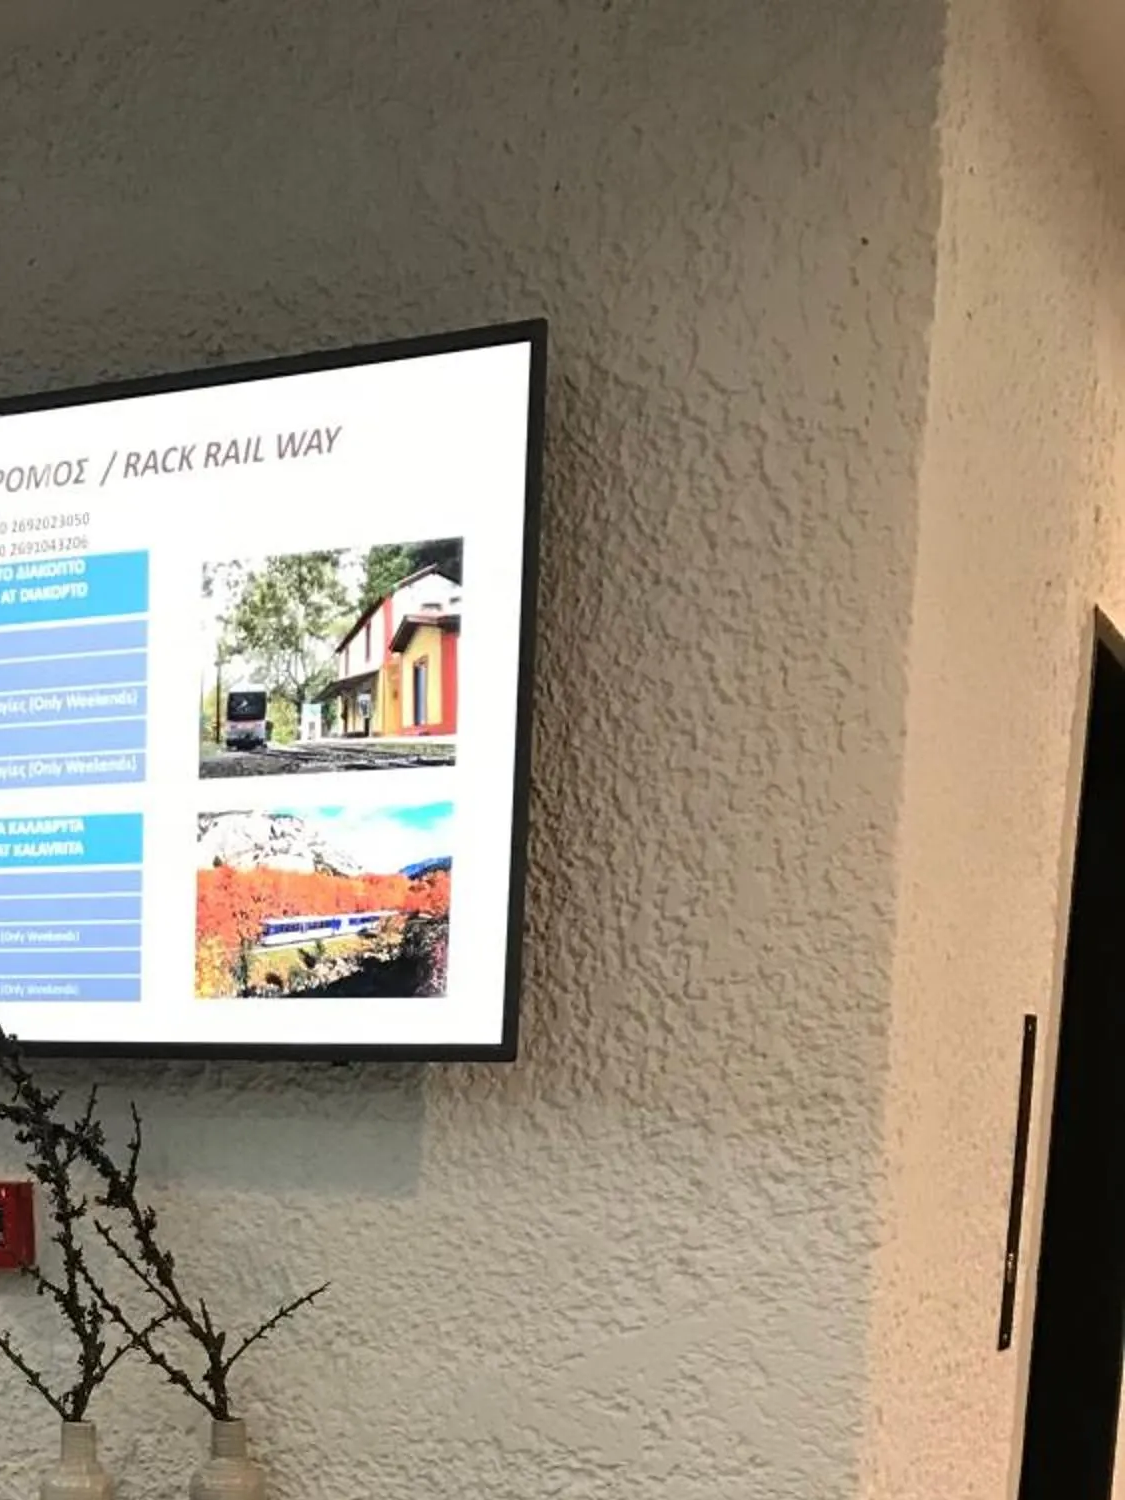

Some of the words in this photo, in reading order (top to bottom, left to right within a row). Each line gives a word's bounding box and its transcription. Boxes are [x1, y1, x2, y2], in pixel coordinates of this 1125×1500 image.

[123, 444, 197, 480] RACK
[203, 434, 265, 469] RAIL
[276, 424, 344, 461] WAY
[0, 588, 17, 605] AT
